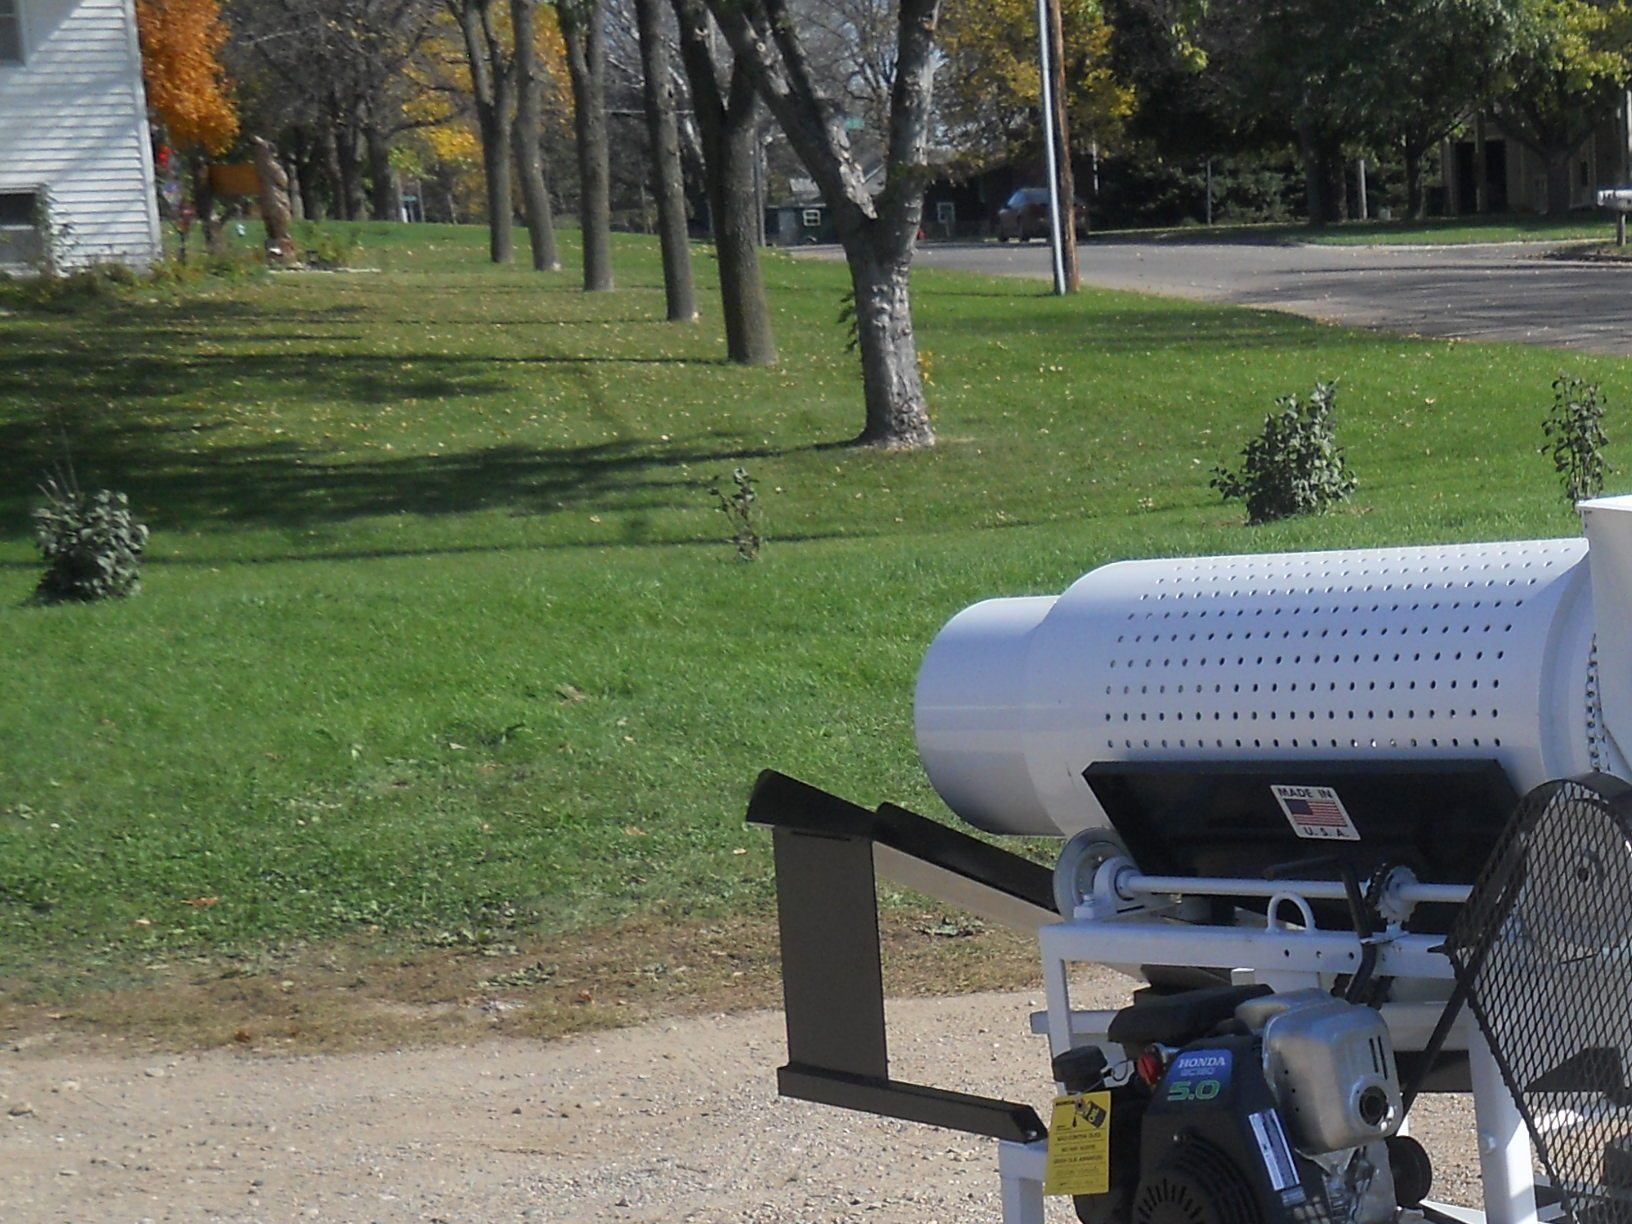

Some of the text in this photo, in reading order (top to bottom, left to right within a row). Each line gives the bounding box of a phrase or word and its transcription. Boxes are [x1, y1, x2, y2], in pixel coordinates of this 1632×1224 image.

[1278, 787, 1334, 799] MADE IN
[1178, 1056, 1226, 1068] HONDA
[1167, 1080, 1220, 1101] 5.0
